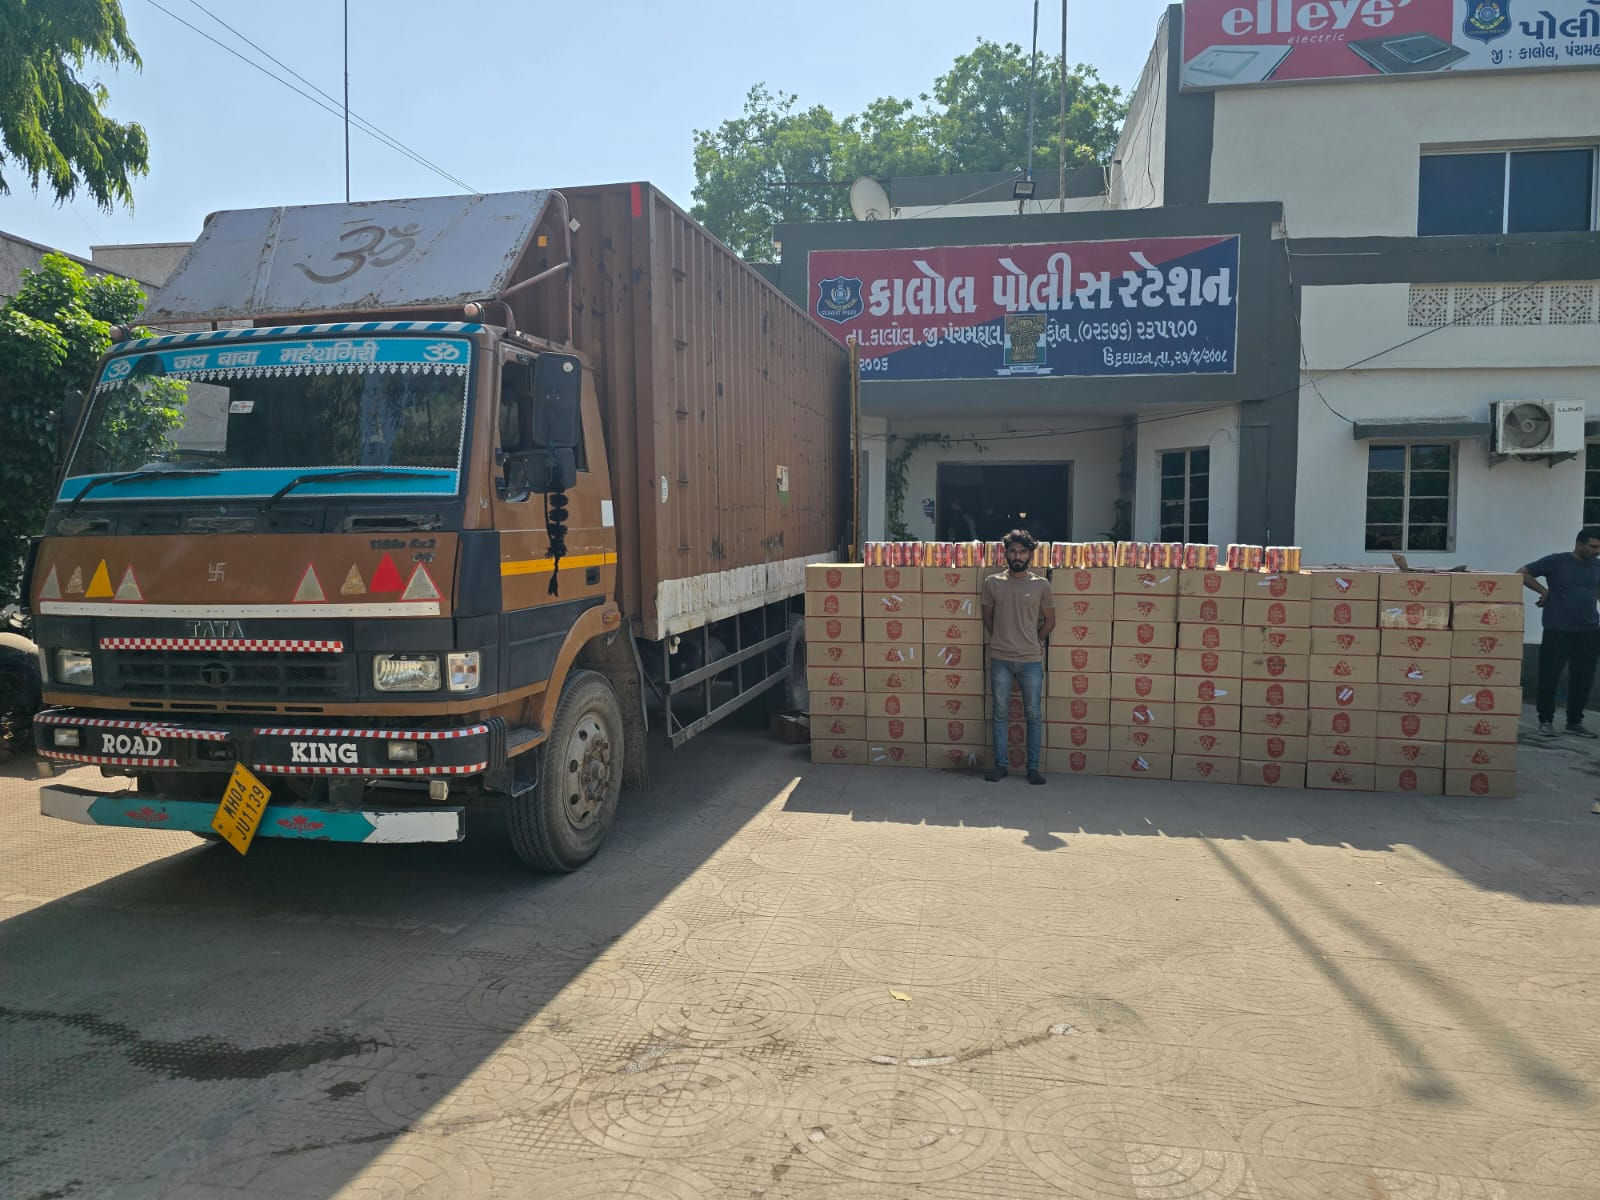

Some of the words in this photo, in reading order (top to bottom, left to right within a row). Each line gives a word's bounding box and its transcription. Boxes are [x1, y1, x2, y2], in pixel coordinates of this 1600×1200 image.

[1287, 32, 1346, 45] electric
[868, 260, 977, 317] કાલોલ
[992, 254, 1112, 311] પોલીસ
[1118, 251, 1232, 307] સ્ટેશન
[173, 353, 206, 371] जय
[217, 349, 261, 367] बाबा
[186, 620, 244, 638] TATA
[102, 734, 162, 756] ROAD
[290, 742, 358, 764] KING
[223, 779, 247, 821] MH04
[235, 785, 265, 841] JU1139
